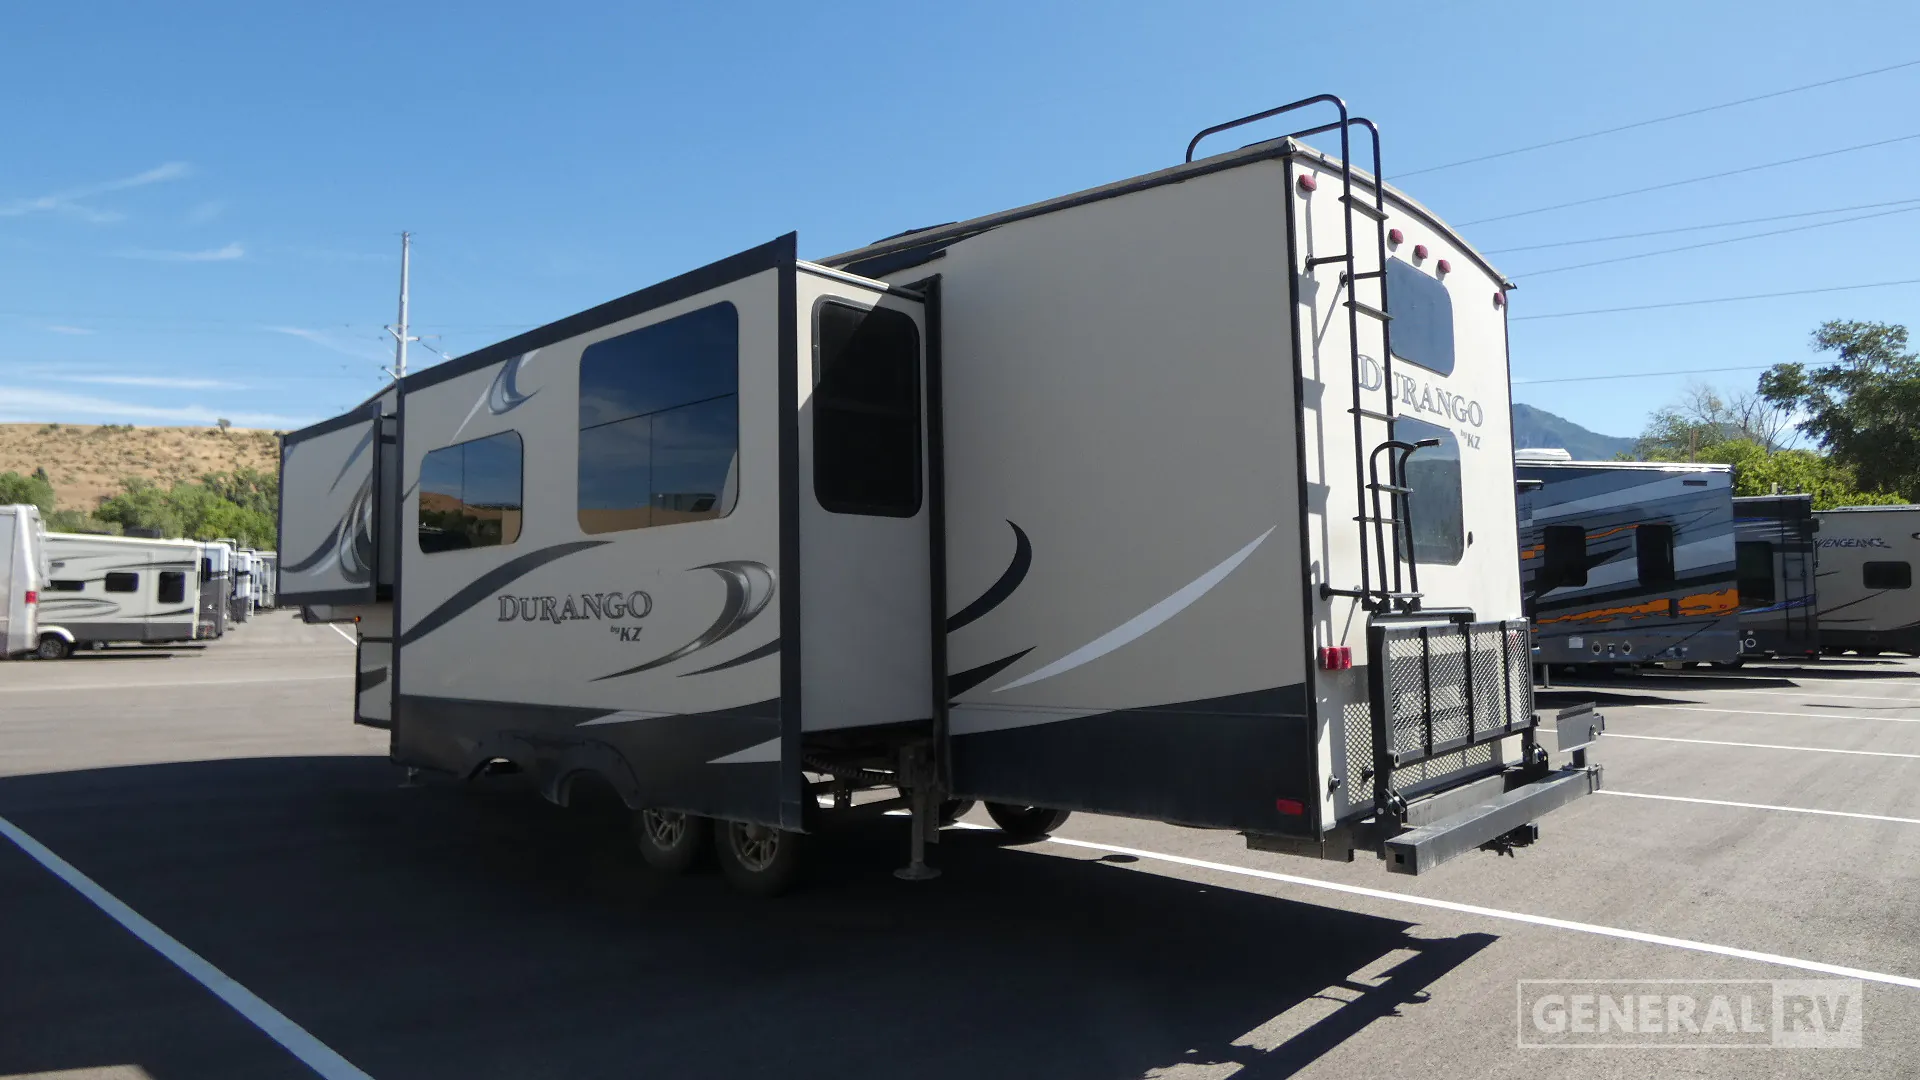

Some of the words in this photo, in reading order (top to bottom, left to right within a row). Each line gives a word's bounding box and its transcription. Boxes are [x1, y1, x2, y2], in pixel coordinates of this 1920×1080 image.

[1358, 354, 1483, 427] DURANGO
[1467, 434, 1481, 450] KZ
[497, 591, 653, 624] DURANGO
[610, 625, 620, 635] by
[619, 627, 643, 642] KZ
